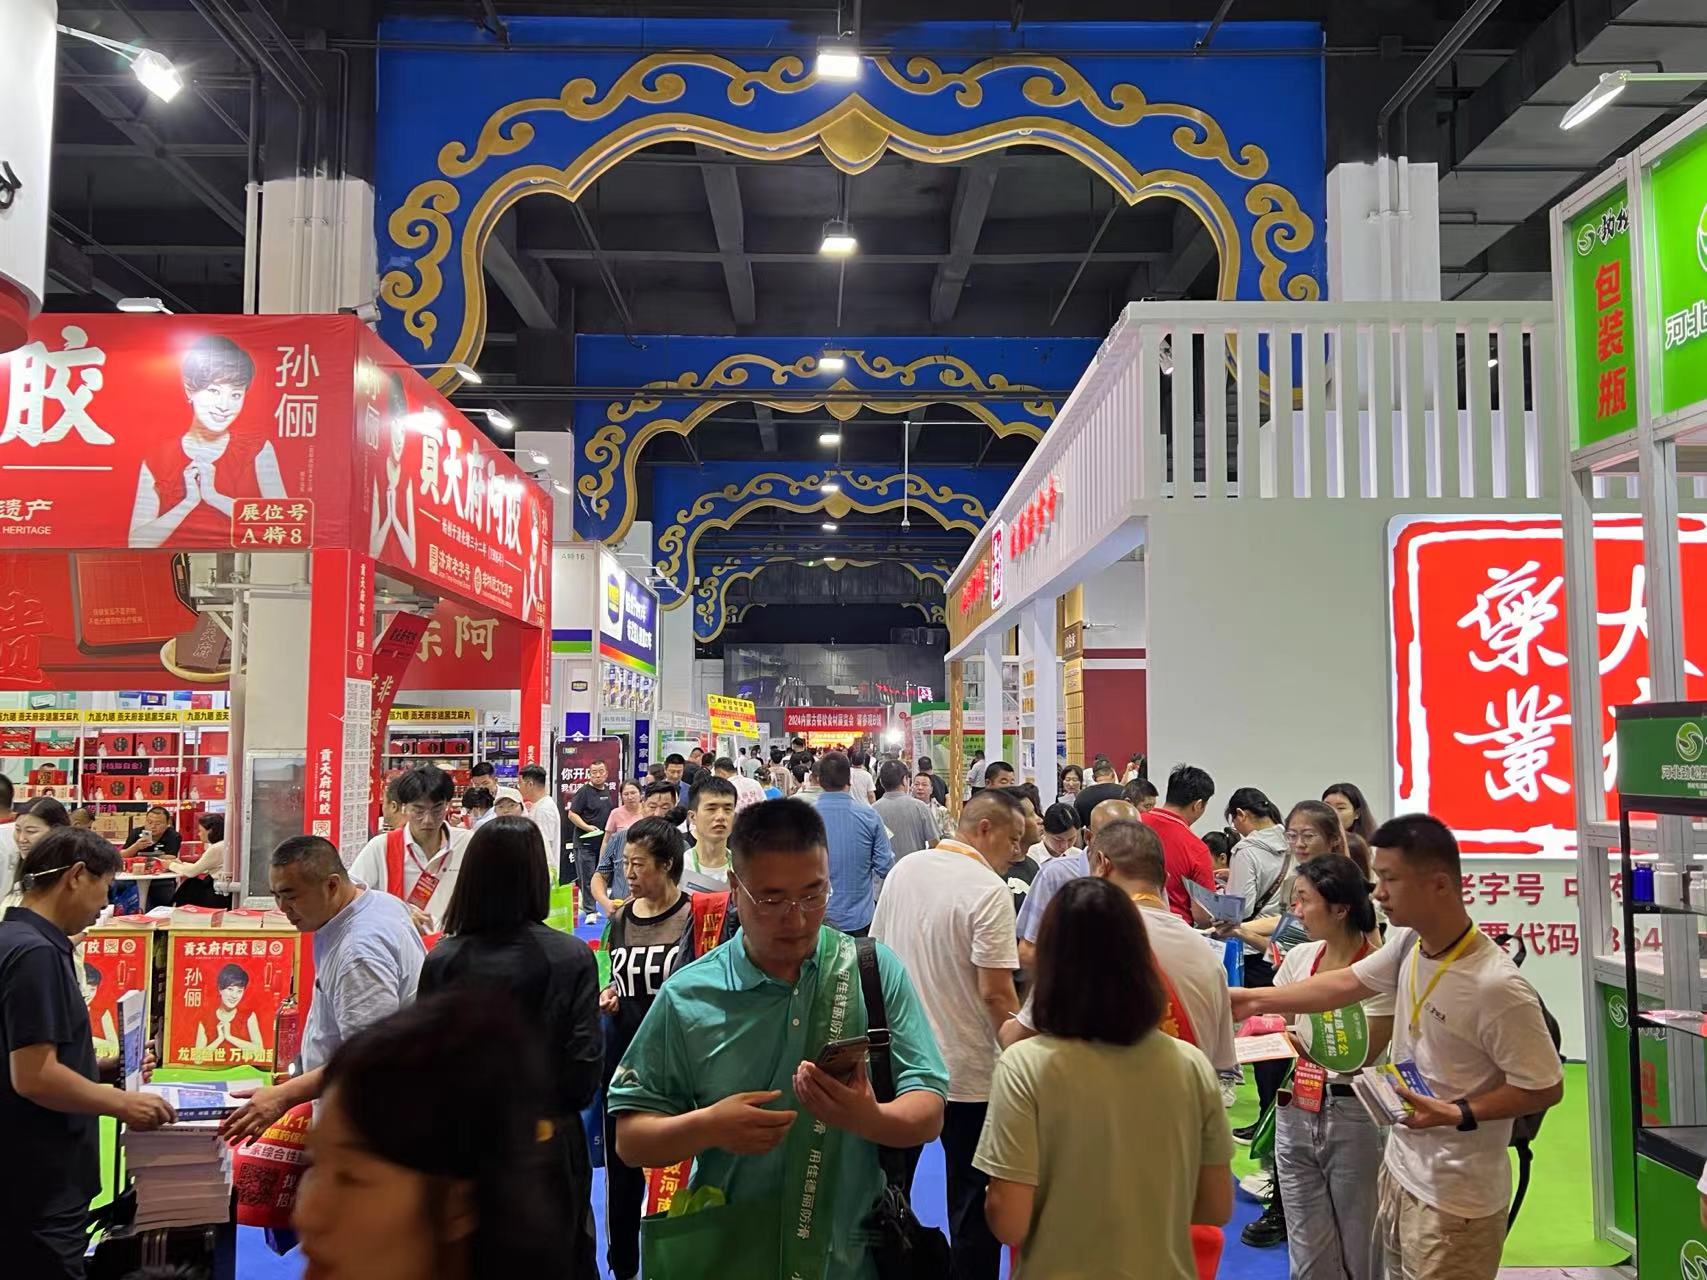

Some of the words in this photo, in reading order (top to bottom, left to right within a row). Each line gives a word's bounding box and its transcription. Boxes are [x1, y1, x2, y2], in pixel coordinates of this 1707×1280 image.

[1594, 259, 1627, 421] 包装瓶
[0, 326, 115, 447] 胶
[275, 344, 320, 438] 孙俪
[2, 525, 51, 536] HERITAGE
[238, 503, 308, 521] 展位号
[184, 967, 203, 1007] 孙俪
